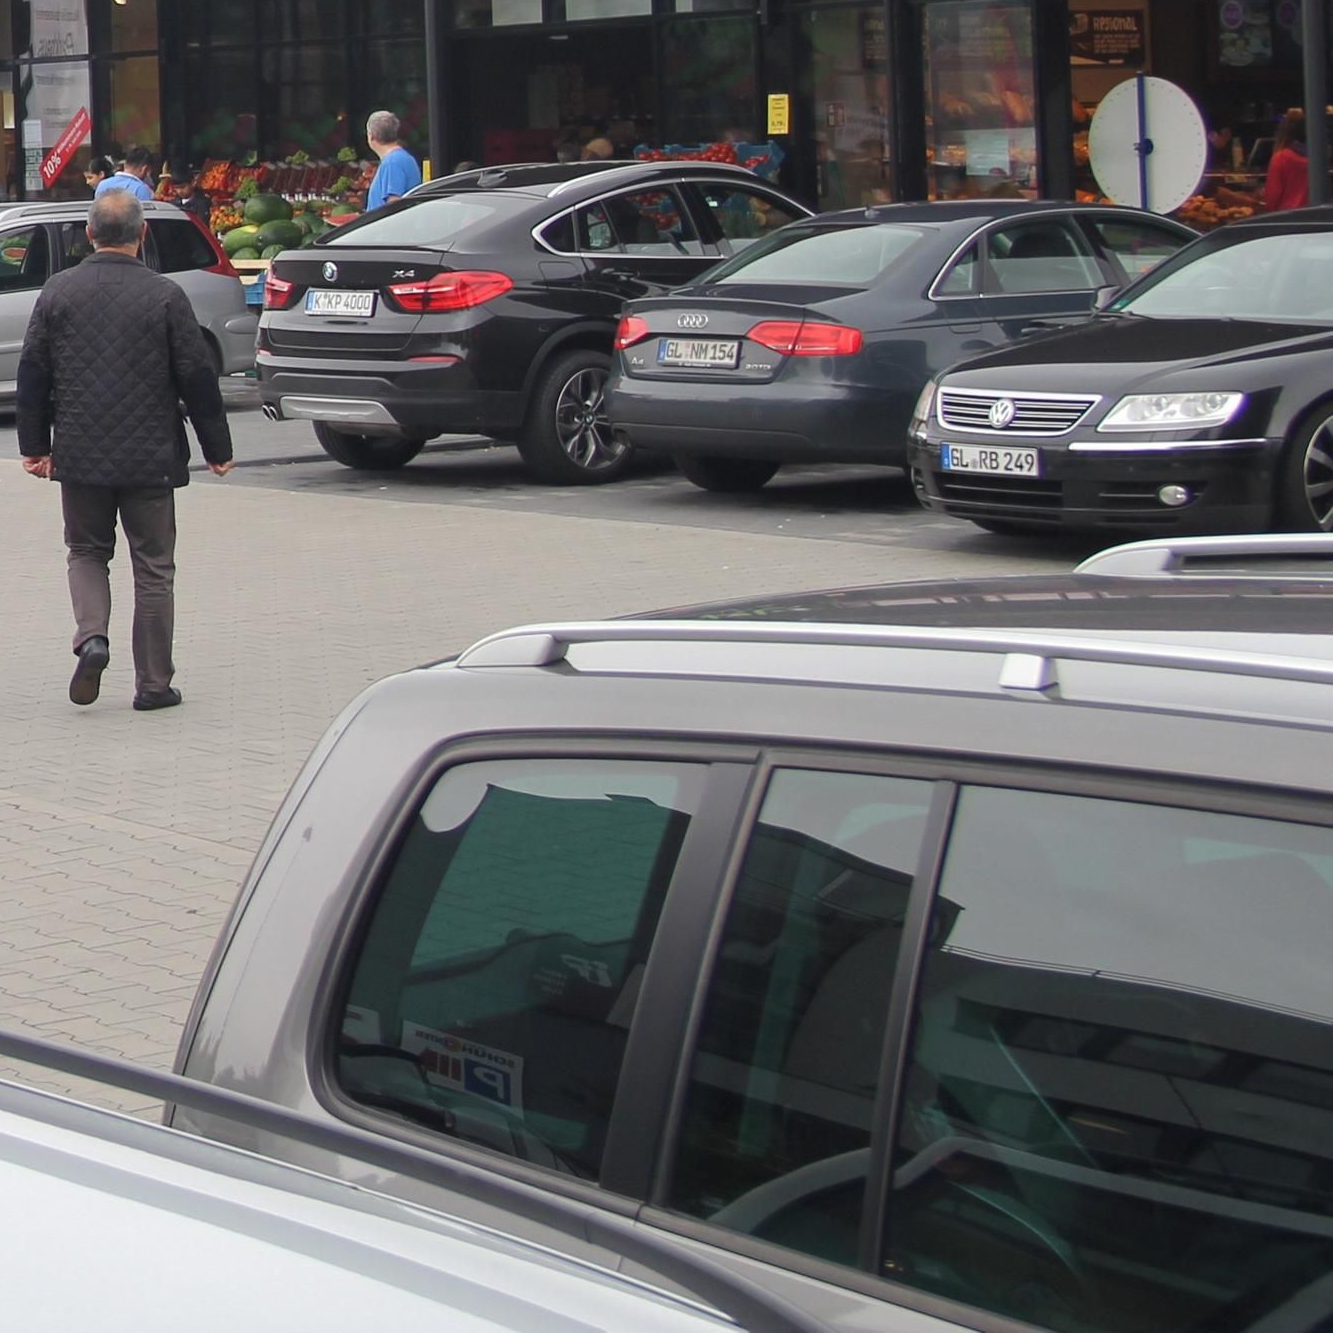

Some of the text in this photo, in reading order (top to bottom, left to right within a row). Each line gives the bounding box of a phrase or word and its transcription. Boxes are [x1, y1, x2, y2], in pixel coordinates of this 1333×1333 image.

[43, 151, 62, 179] 10%
[391, 269, 415, 278] X4
[666, 341, 735, 361] GL NM 154
[950, 447, 1035, 473] GL RB 249
